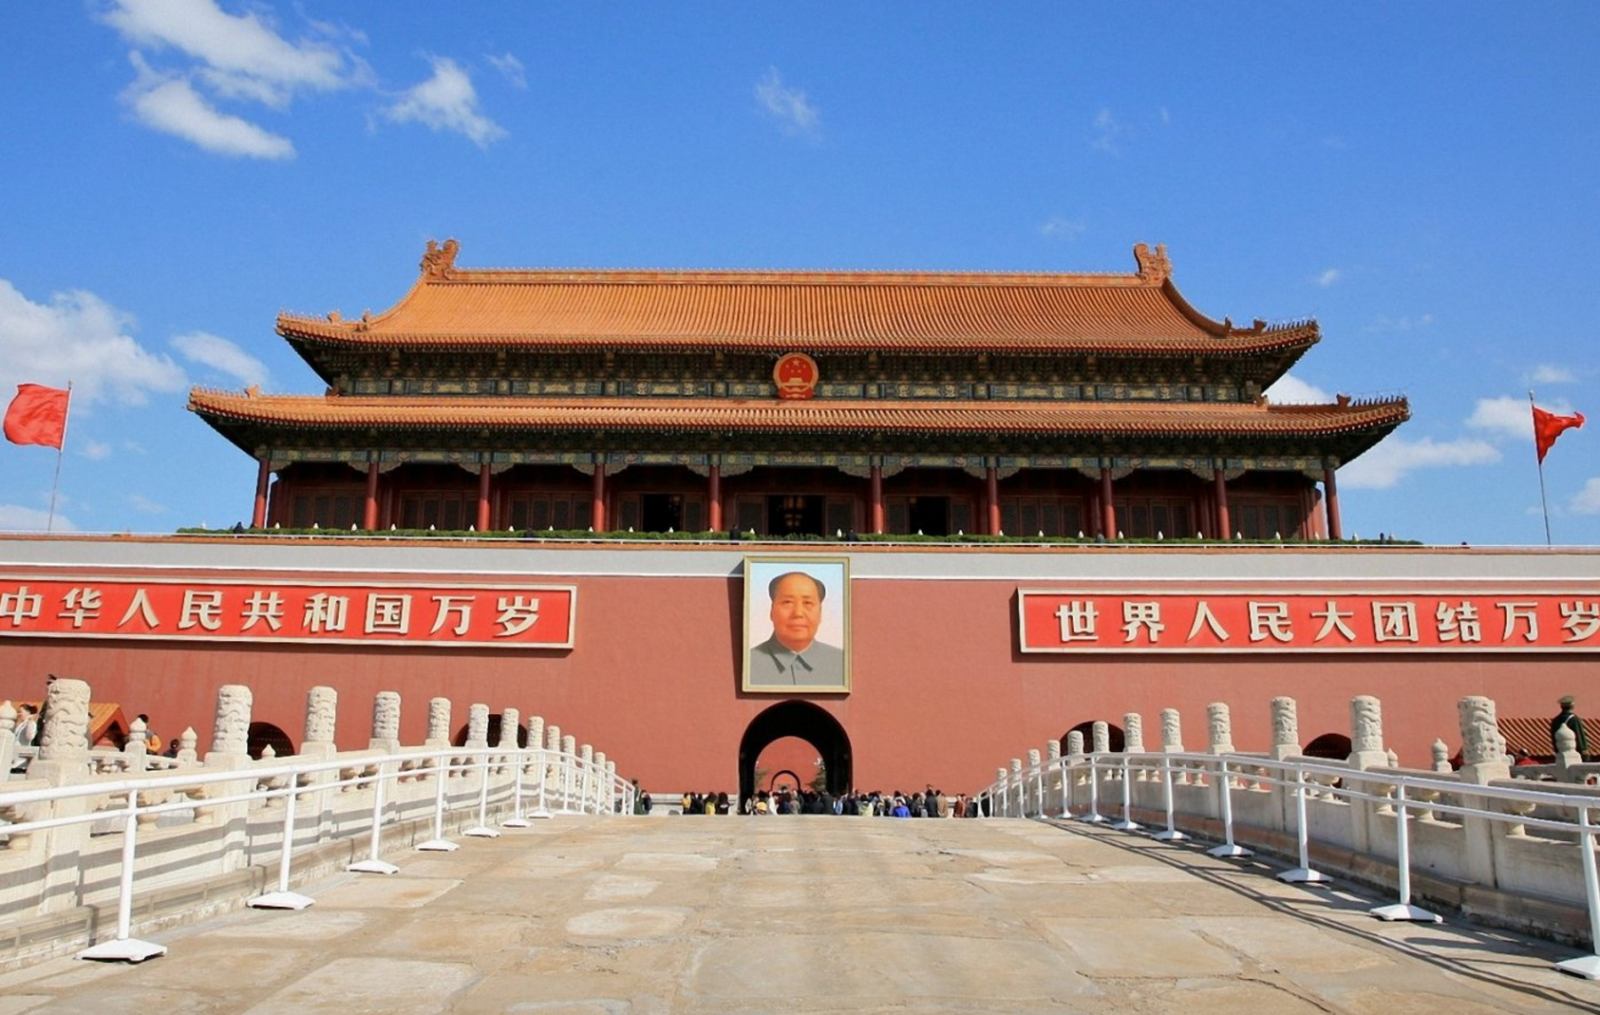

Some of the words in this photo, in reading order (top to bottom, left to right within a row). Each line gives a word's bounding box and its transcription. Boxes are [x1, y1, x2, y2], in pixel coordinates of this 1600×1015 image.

[0, 586, 540, 637] 中华人民共和国万岁
[1055, 600, 1600, 642] 世界人民大团结万岁
